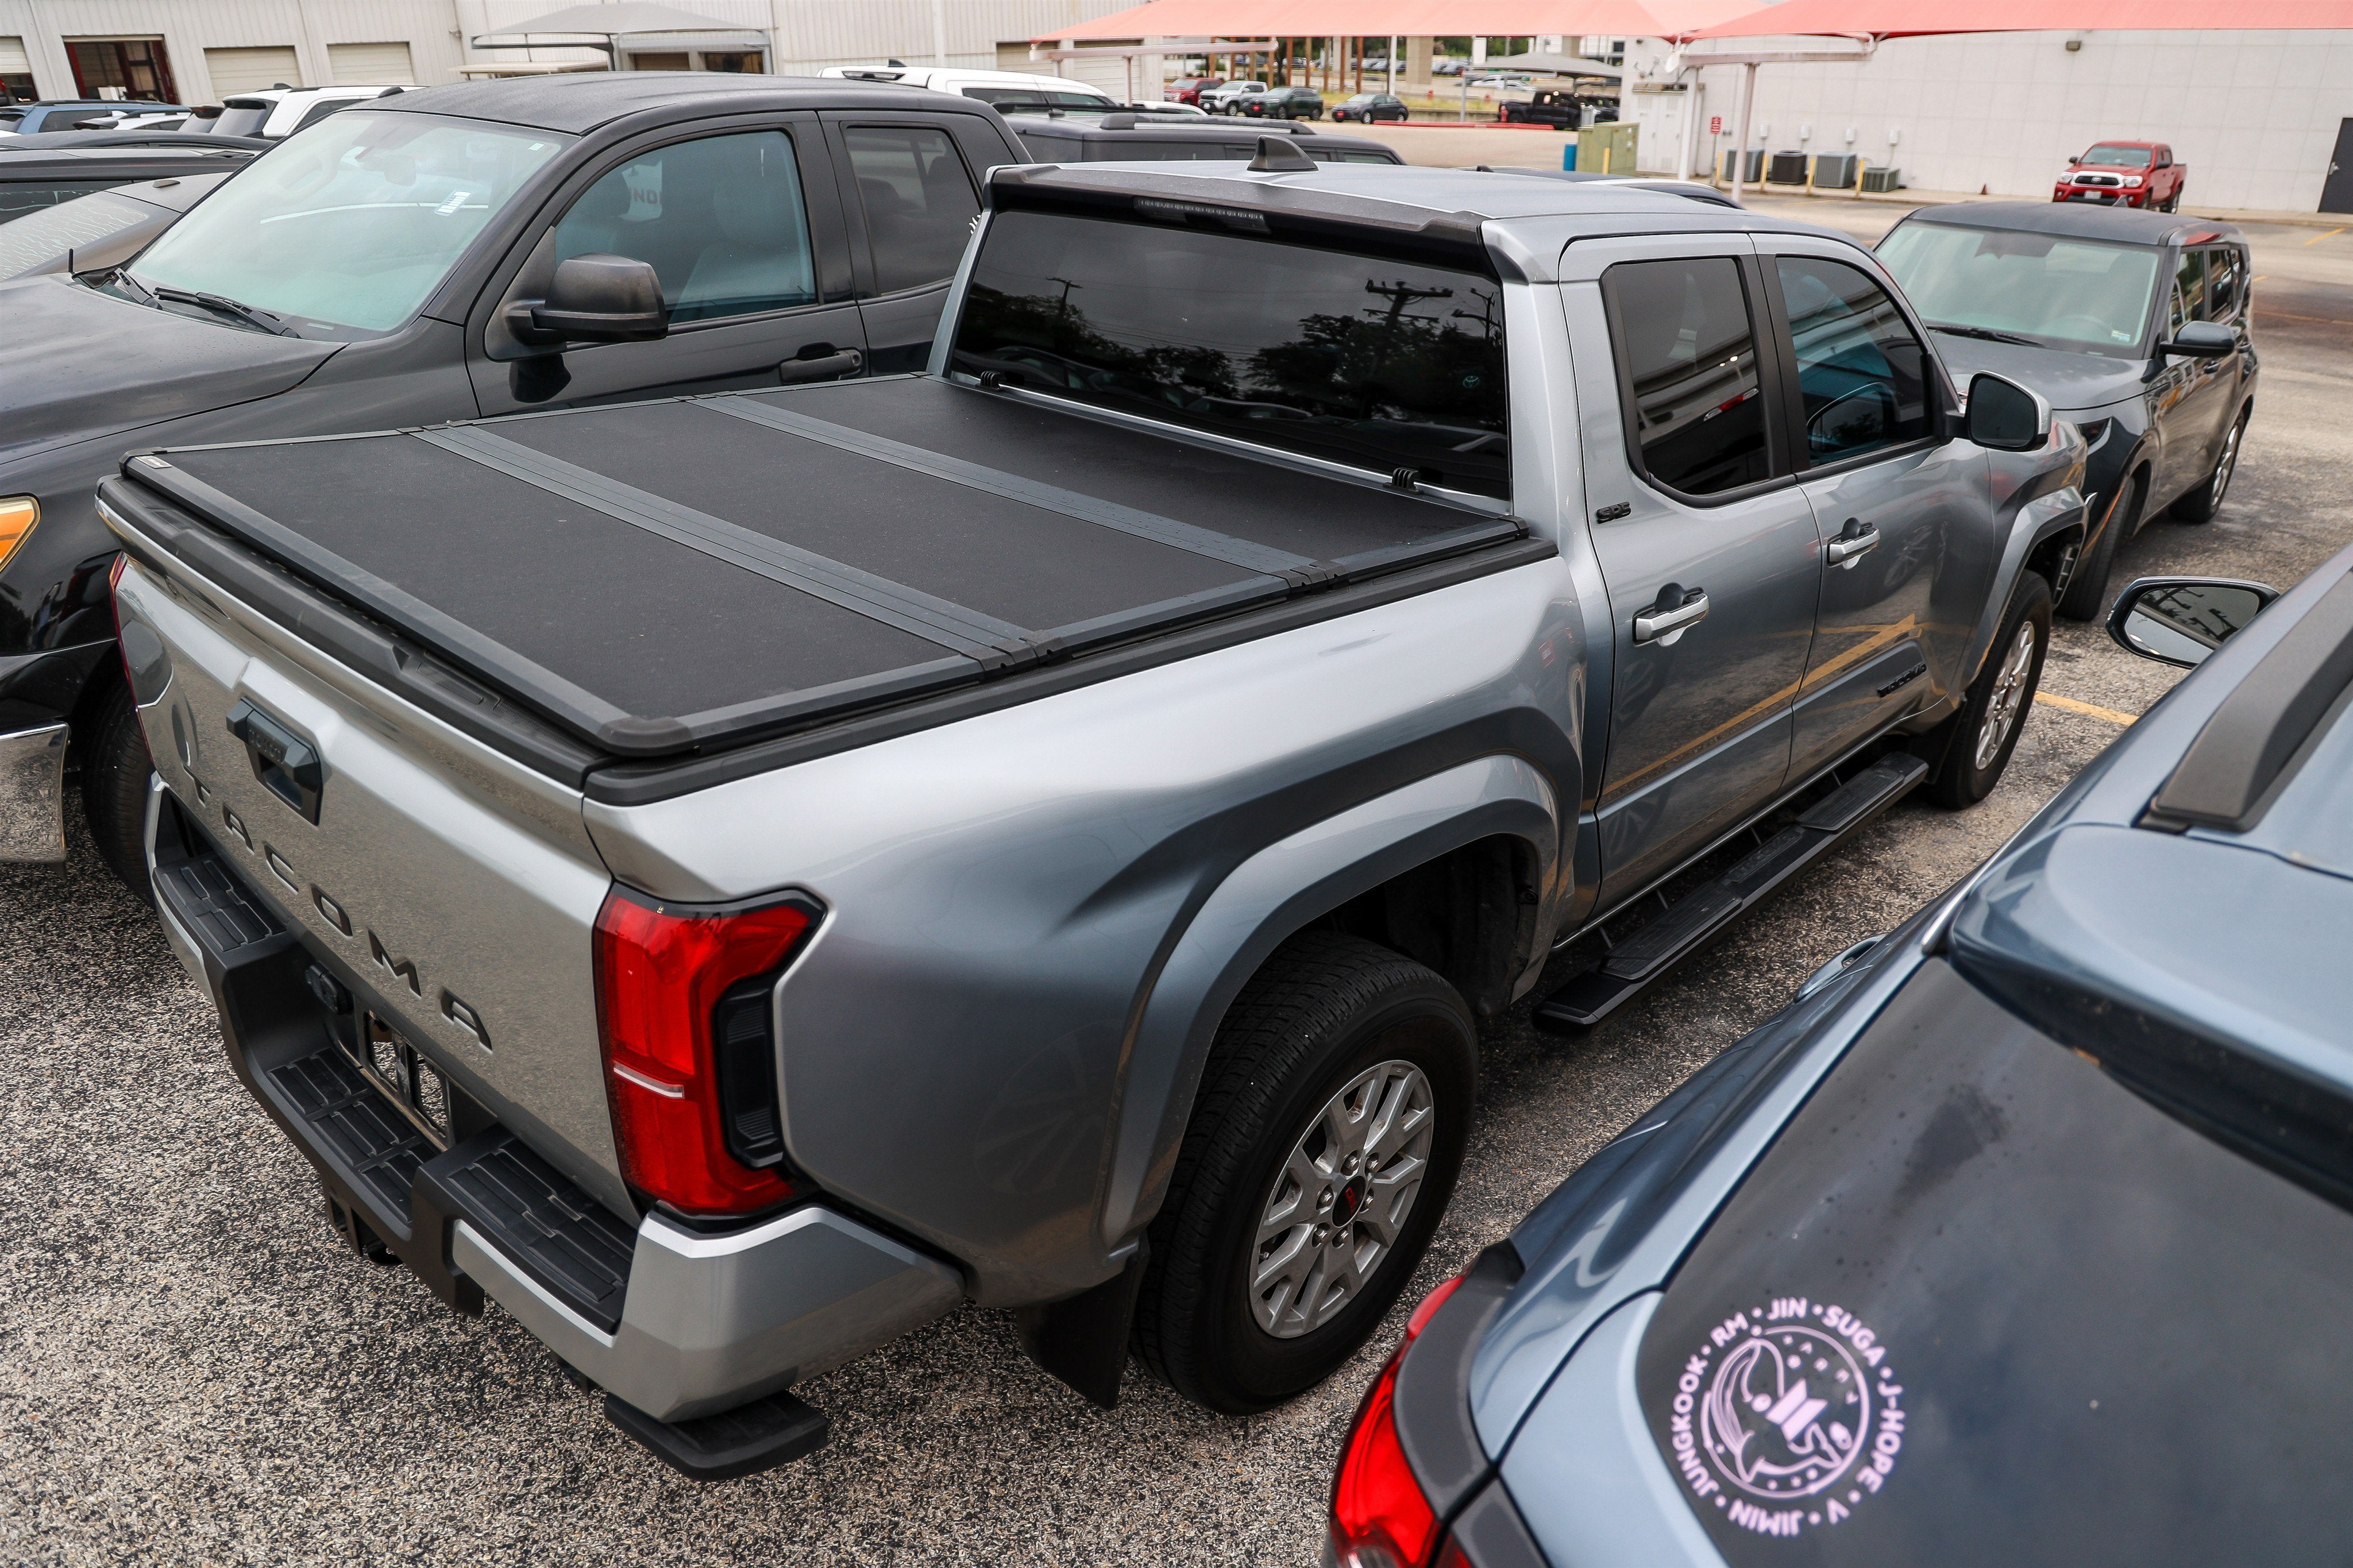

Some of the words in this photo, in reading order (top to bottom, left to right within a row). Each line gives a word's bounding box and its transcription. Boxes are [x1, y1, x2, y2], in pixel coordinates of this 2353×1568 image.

[1596, 501, 1632, 524] SR5
[183, 764, 493, 1052] TACOMA
[1766, 1296, 1808, 1322] JIN
[1710, 1311, 1750, 1348] RM
[1821, 1304, 1887, 1368] SUGA
[1670, 1354, 1720, 1497] JUNGKOOK
[1856, 1381, 1906, 1494] J-HOPE
[1727, 1498, 1804, 1537] JIMIN
[1826, 1497, 1850, 1525] V
